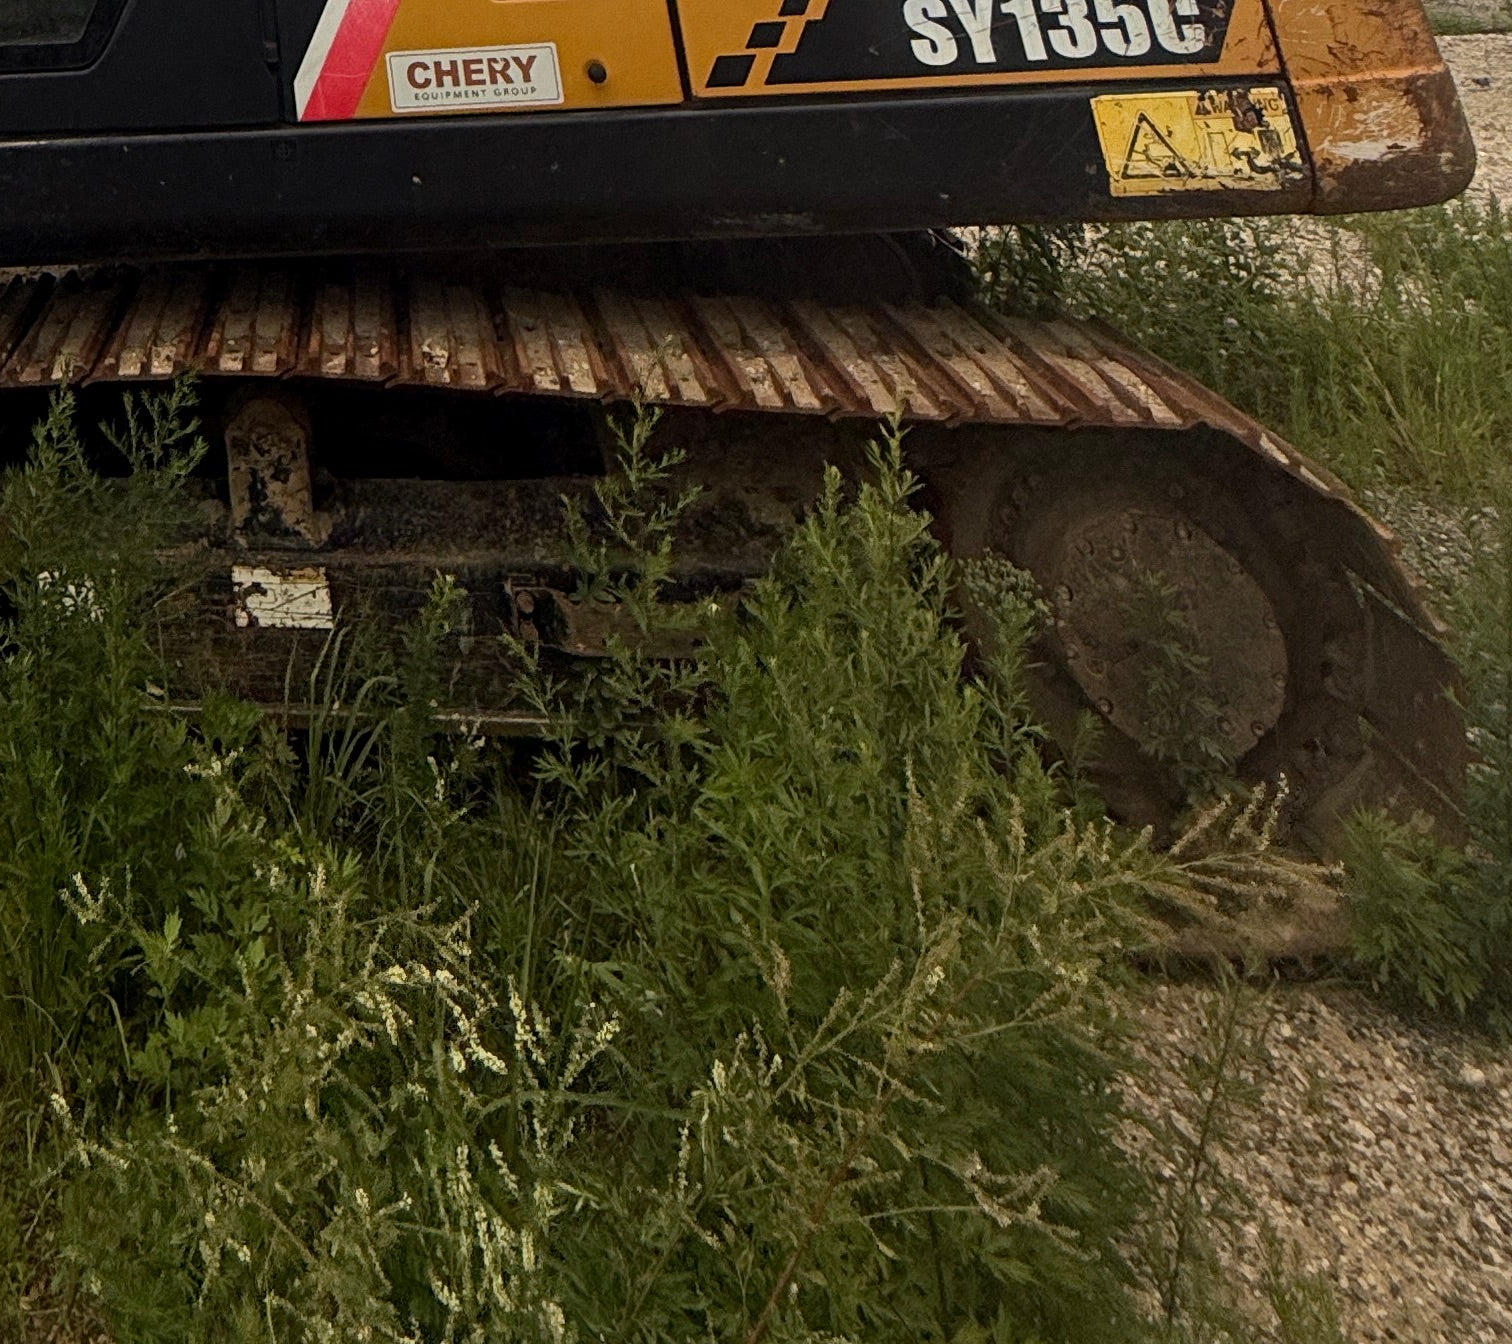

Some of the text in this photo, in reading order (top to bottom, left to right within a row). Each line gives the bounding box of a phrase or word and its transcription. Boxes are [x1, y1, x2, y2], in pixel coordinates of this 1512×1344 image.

[407, 55, 537, 89] CHERY
[414, 86, 537, 101] EQUIPMENT GROUP
